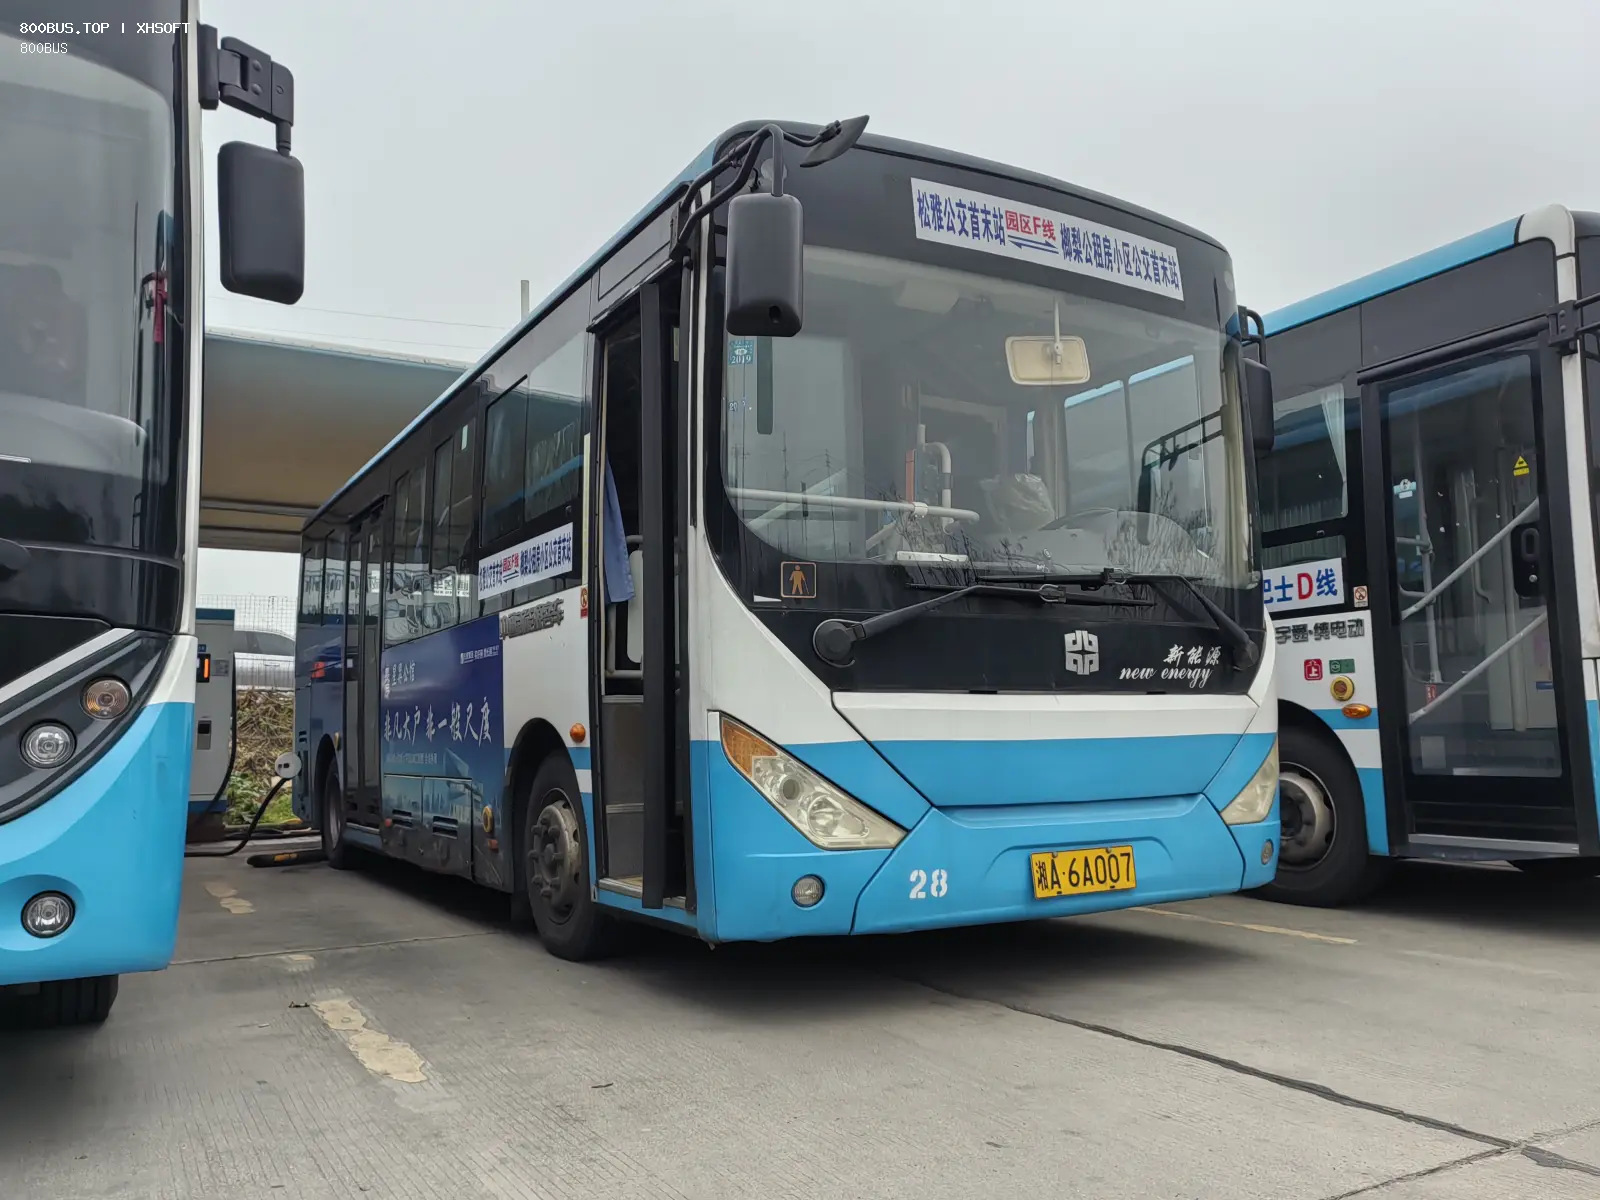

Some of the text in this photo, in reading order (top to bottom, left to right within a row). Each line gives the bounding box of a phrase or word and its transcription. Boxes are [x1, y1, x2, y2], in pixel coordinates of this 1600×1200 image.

[917, 188, 1006, 246] 松雅公交首末站
[1004, 209, 1056, 242] 园区F线
[731, 354, 752, 364] 2019
[1163, 643, 1222, 667] 新能源
[1119, 666, 1213, 689] new energy
[1309, 666, 1319, 677] 上
[909, 868, 949, 899] 28
